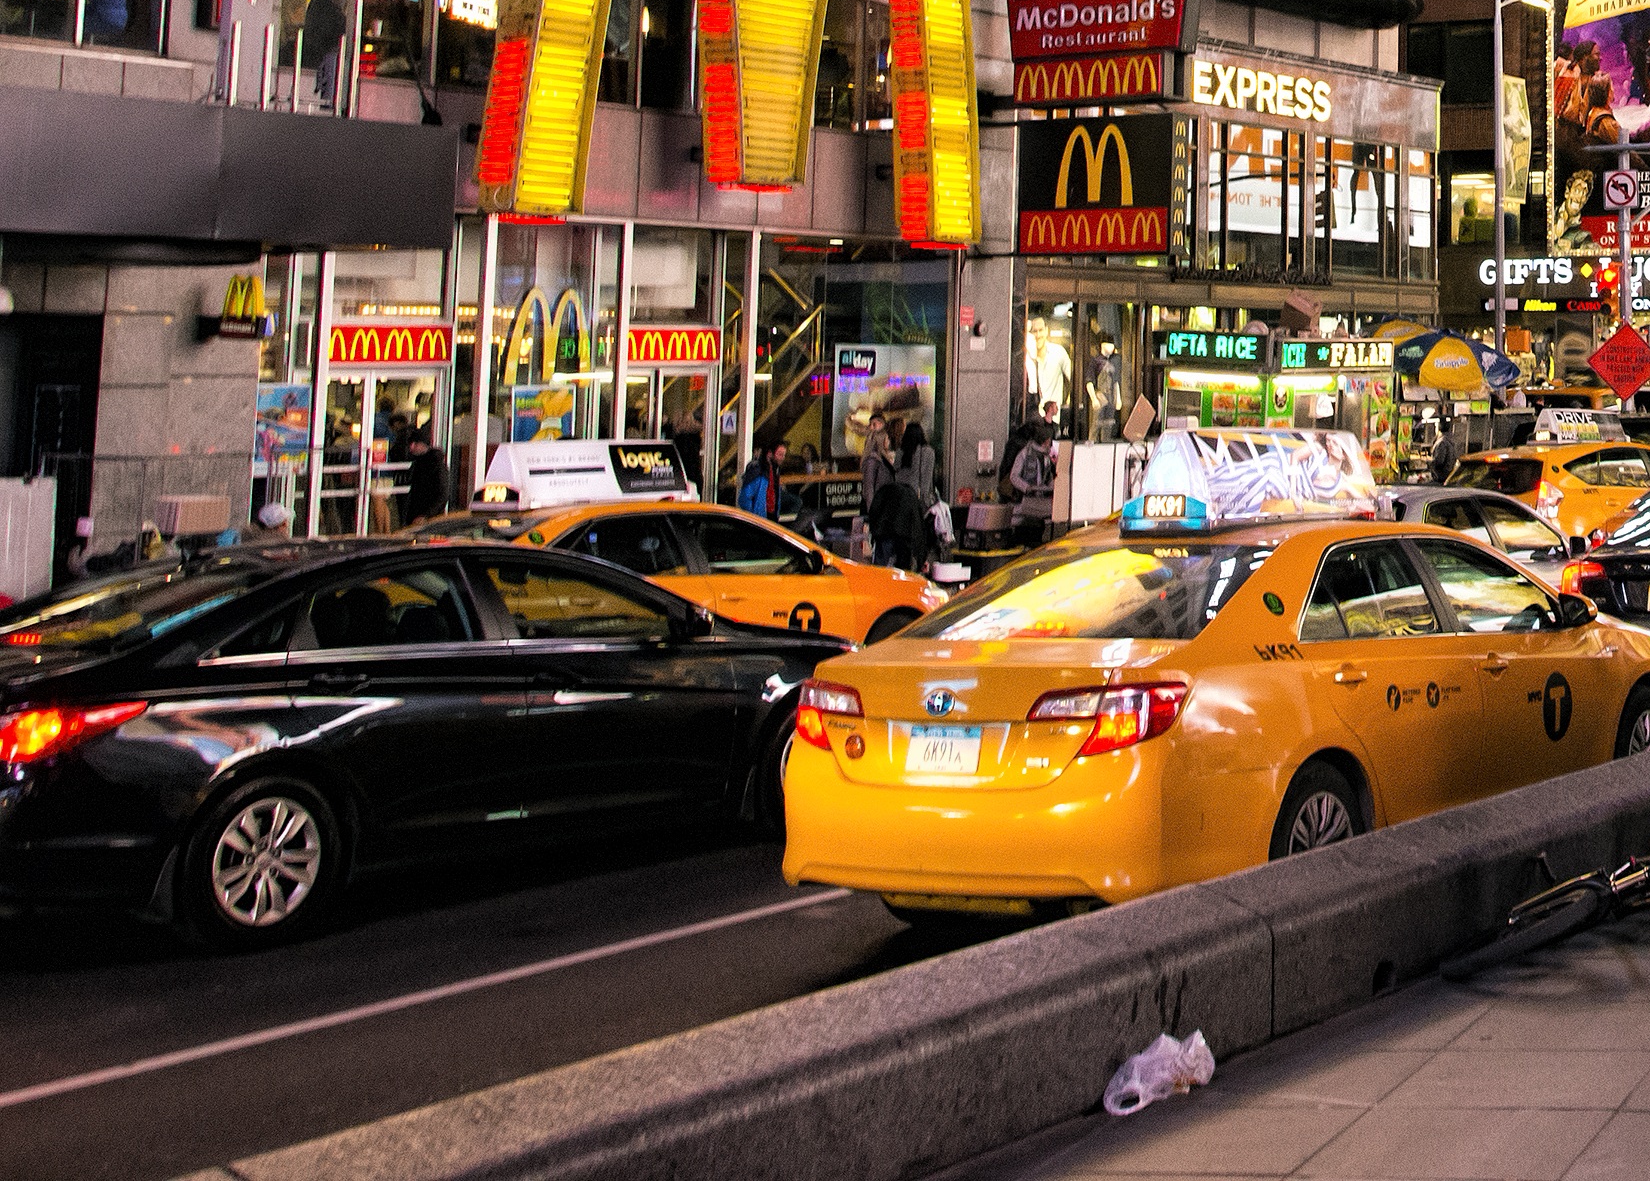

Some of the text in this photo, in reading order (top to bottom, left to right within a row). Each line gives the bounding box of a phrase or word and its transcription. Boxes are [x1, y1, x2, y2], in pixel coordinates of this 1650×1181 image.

[1041, 27, 1148, 50] Restaurant
[1192, 59, 1332, 122] EXPRESS
[1600, 235, 1615, 245] ON
[1479, 258, 1574, 285] GIFTS
[1523, 299, 1557, 312] Nikon
[1566, 299, 1602, 312] Cano
[1216, 335, 1257, 361] RICE
[853, 353, 873, 372] day
[1554, 410, 1596, 426] DRIVE
